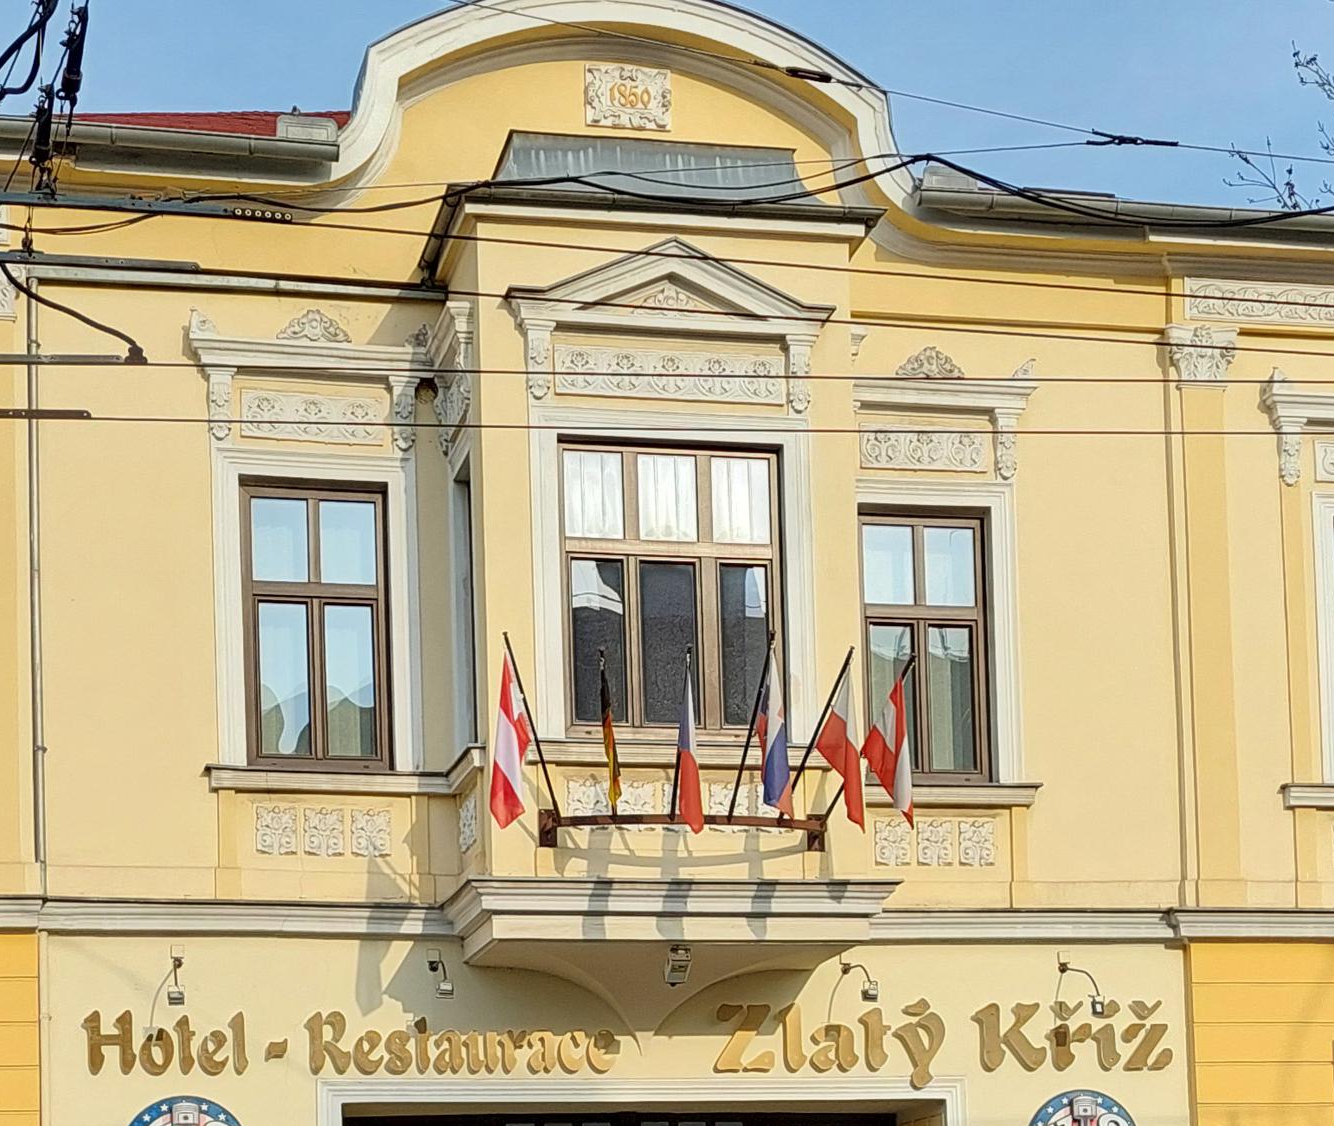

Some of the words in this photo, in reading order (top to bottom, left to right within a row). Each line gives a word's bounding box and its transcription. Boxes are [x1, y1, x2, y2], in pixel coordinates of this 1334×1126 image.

[82, 1010, 248, 1075] Hotel
[265, 1037, 287, 1060] -
[304, 1010, 620, 1075] Restaurace
[714, 998, 945, 1088] Zlatý
[971, 998, 1174, 1072] Kříž
